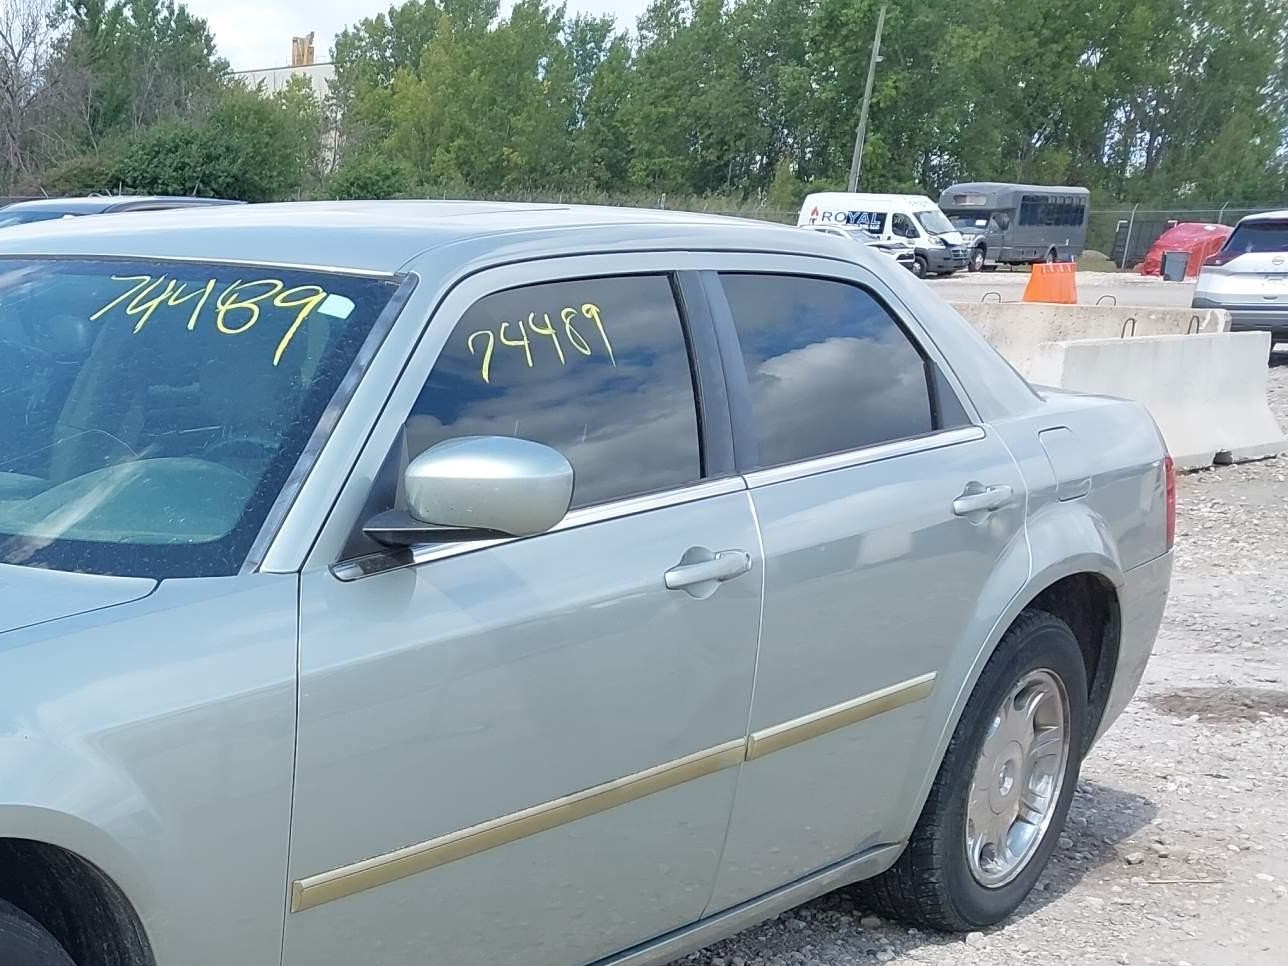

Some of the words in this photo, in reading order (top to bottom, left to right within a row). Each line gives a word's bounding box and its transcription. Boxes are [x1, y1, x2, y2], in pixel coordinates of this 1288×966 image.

[821, 211, 881, 225] ROYAL
[90, 273, 327, 366] 74489
[468, 303, 616, 384] 74489
